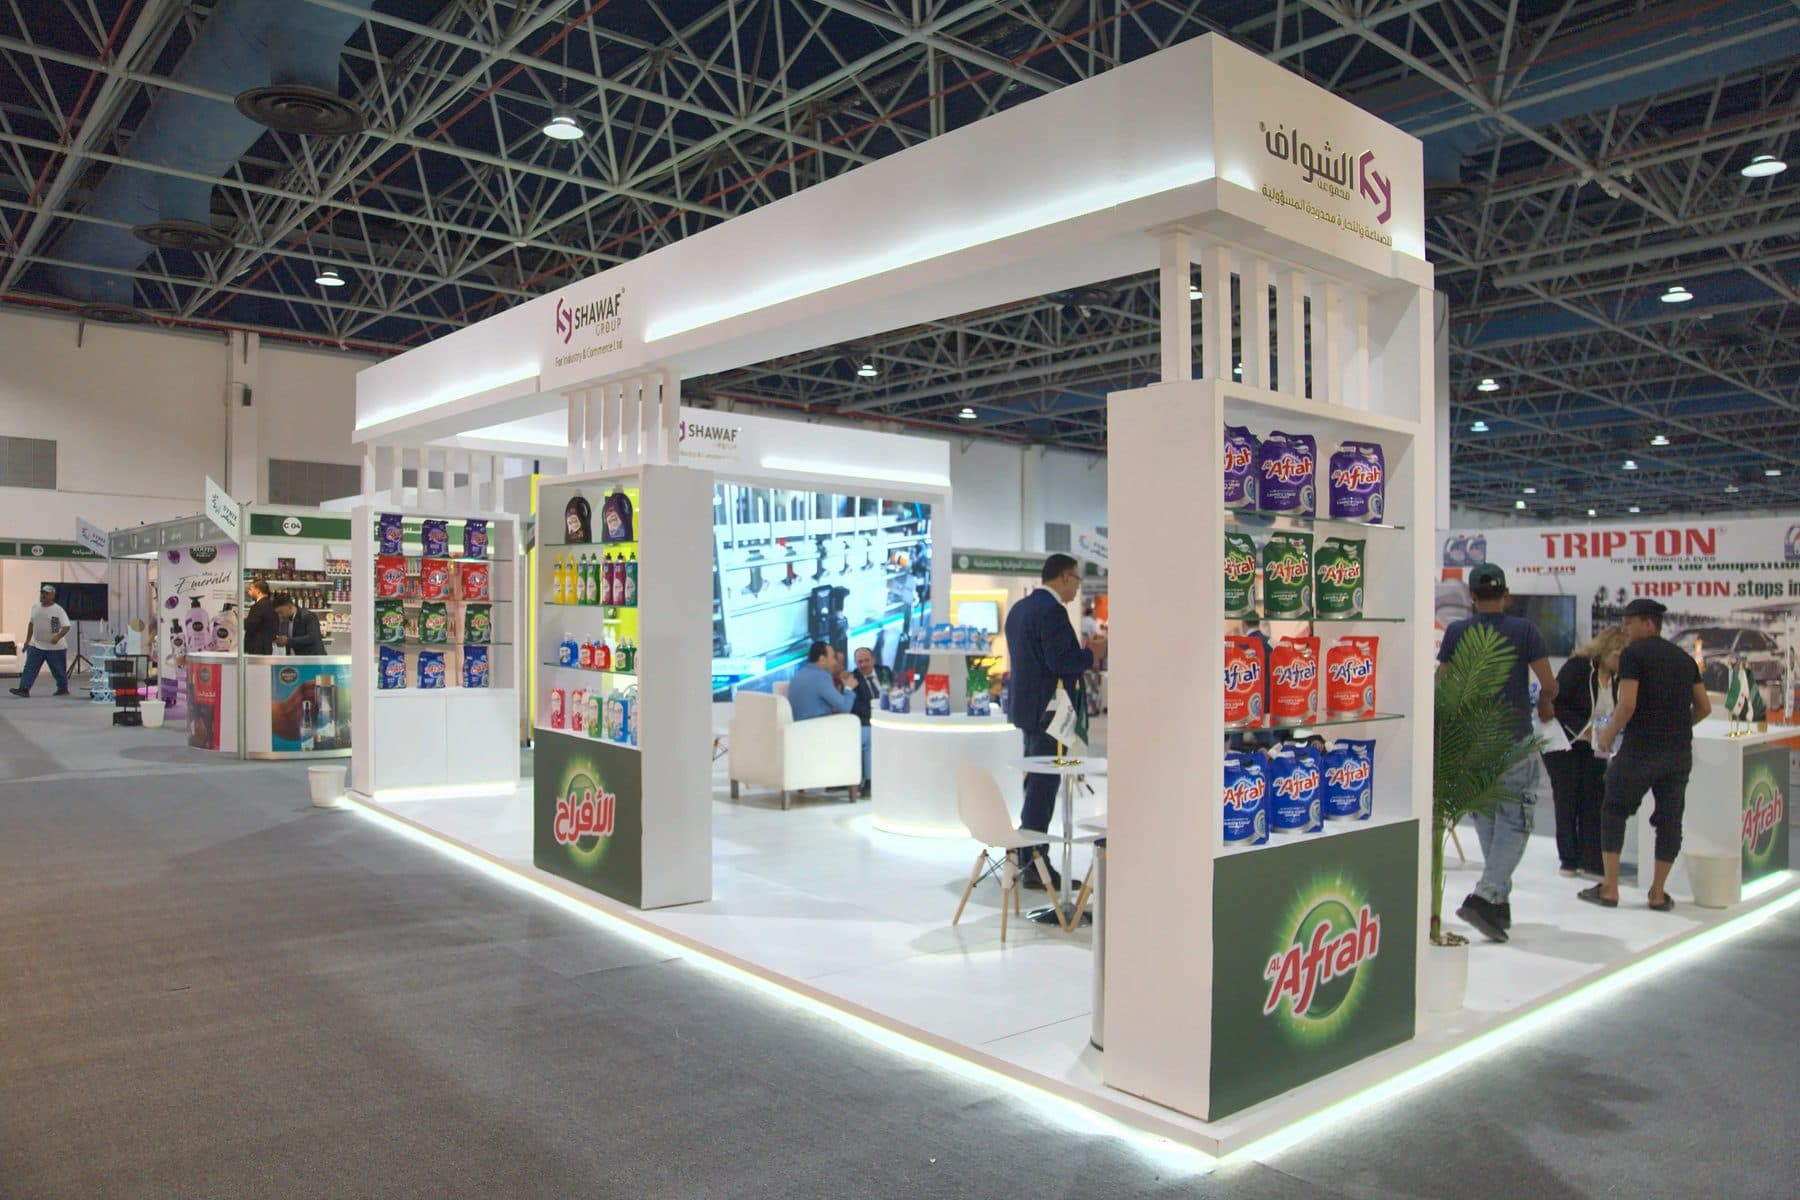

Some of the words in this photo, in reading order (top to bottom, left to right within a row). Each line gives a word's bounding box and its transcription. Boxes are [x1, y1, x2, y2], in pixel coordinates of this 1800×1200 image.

[574, 293, 621, 330] SHAWAF
[595, 317, 621, 336] GROUP
[688, 424, 737, 442] SHAWAF
[1336, 466, 1381, 490] Afrah
[1540, 527, 1716, 559] TRIPTON
[1631, 580, 1730, 597] TRIPTON
[1334, 660, 1373, 684] Afrah
[1278, 771, 1319, 799] Afrah
[1329, 763, 1369, 788] Afrah
[555, 788, 614, 842] الأفراح
[1742, 788, 1783, 850] Afrah
[1265, 906, 1379, 1014] Afrah
[1266, 956, 1281, 977] AL
